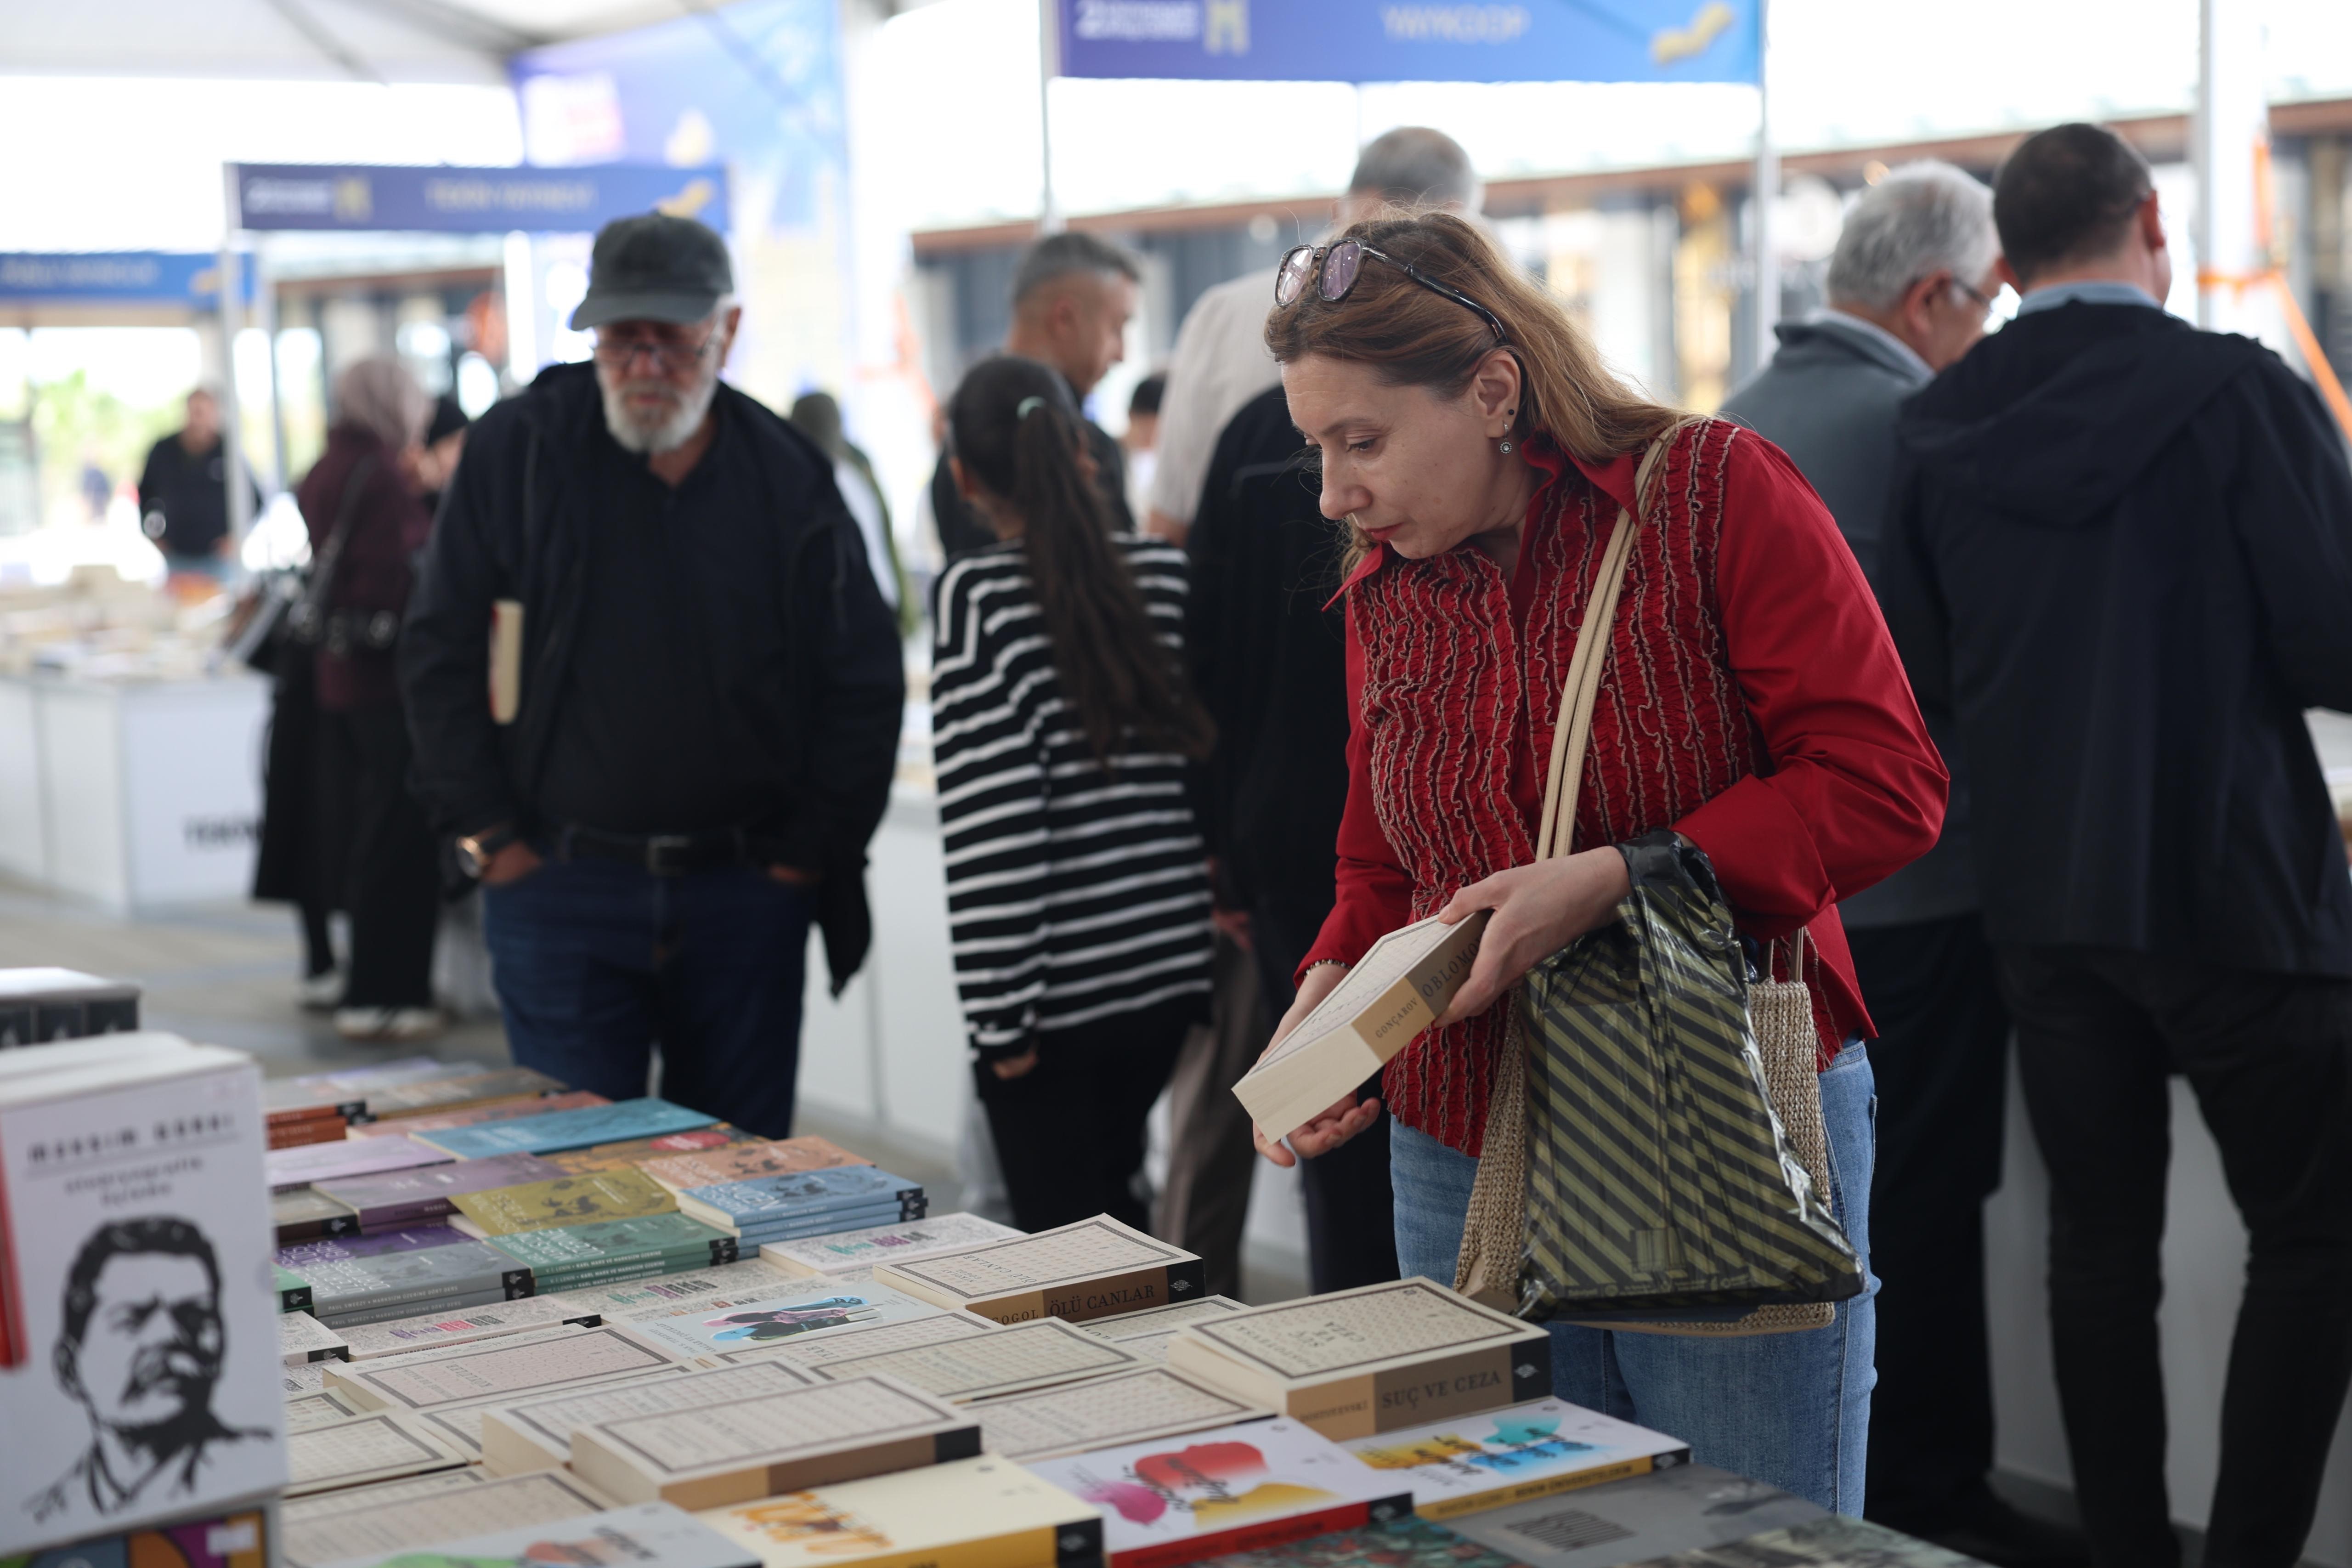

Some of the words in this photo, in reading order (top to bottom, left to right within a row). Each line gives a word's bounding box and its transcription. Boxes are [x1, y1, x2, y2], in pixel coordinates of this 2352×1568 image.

[1375, 998, 1418, 1038] GONÇAROV
[963, 1255, 1012, 1273] CANLAR
[956, 1268, 982, 1279] GOGOL
[1007, 1273, 1037, 1283] ÖLÜ
[344, 1300, 366, 1309] SWEEZY
[1050, 1295, 1081, 1317] ÖLÜ
[1087, 1285, 1155, 1309] CANLAR
[347, 1316, 369, 1325] SWEEZY
[1382, 1387, 1419, 1410] SUÇ
[1424, 1380, 1449, 1398] VE
[1454, 1370, 1502, 1393] CEZA
